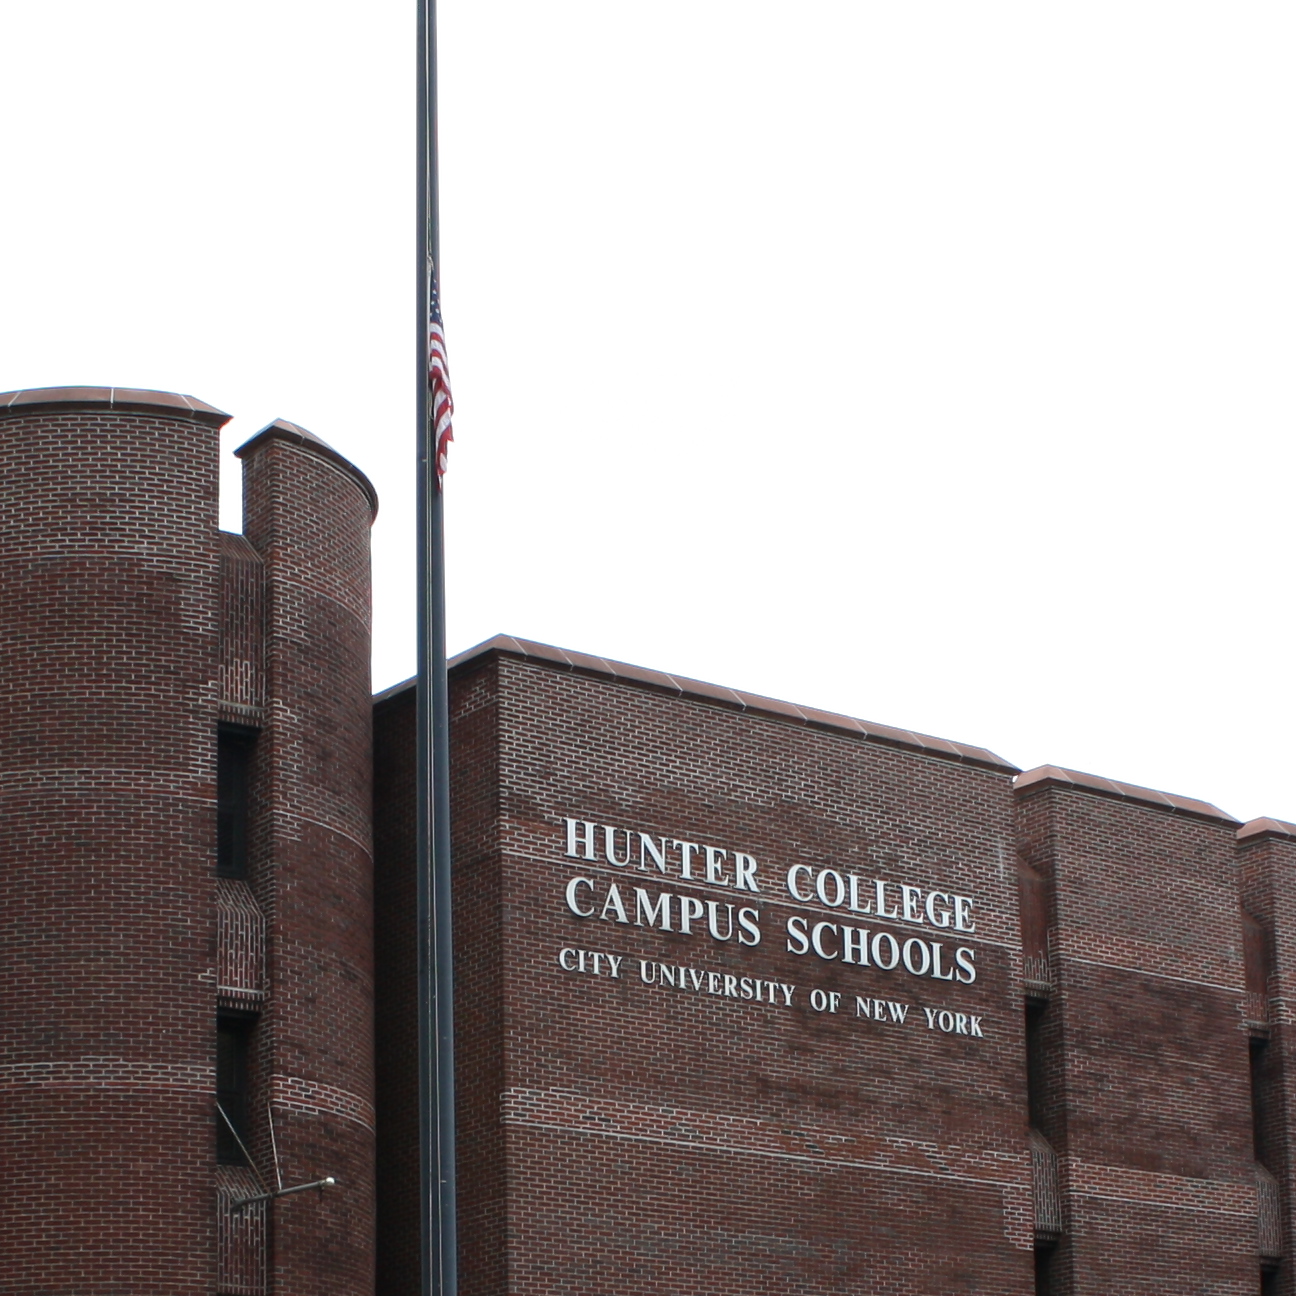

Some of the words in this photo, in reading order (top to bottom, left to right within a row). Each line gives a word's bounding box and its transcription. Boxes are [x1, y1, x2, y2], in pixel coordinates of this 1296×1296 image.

[563, 817, 760, 893] HUNTER
[786, 863, 976, 933] COLLEGE
[565, 876, 762, 947] CAMPUS
[786, 916, 977, 984] SCHOOLS
[558, 947, 623, 979] CITY
[639, 960, 796, 1007] UNIVERSITY
[810, 988, 842, 1013] OF
[855, 996, 909, 1024] NEW
[923, 1007, 984, 1038] YORK
